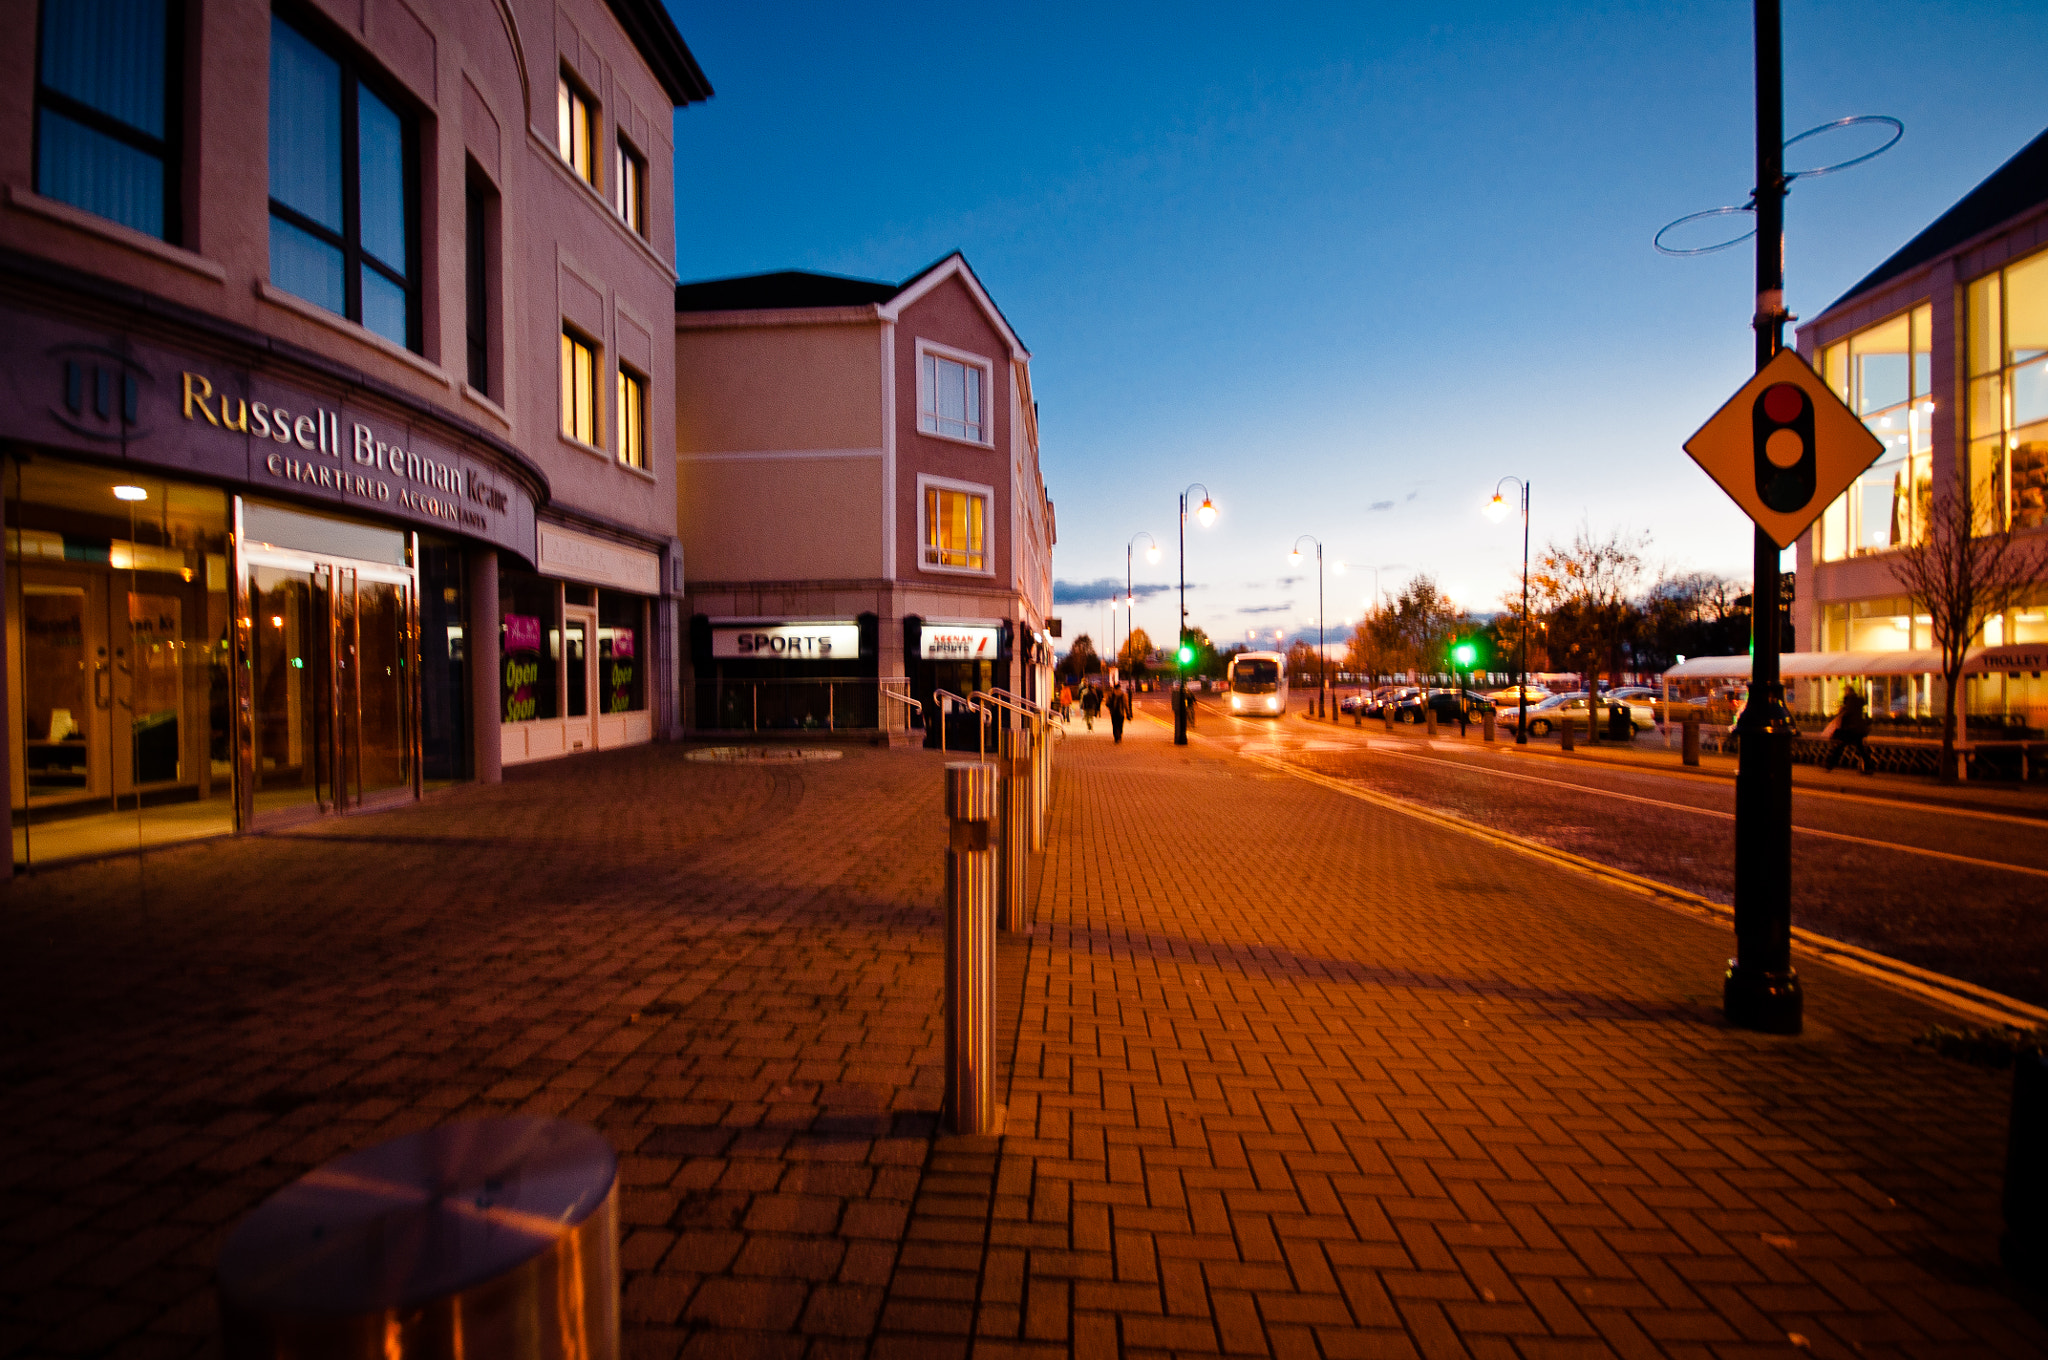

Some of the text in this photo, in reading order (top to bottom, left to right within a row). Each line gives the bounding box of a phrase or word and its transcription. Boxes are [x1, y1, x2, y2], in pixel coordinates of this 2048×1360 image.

[182, 371, 339, 457] Russell
[353, 422, 462, 498] Brennan
[267, 453, 389, 502] CHARTERED
[738, 634, 833, 653] SPORTS
[1981, 655, 2041, 667] TROLLEY
[506, 660, 538, 694] Open
[612, 662, 632, 691] Open
[505, 695, 536, 723] Soon
